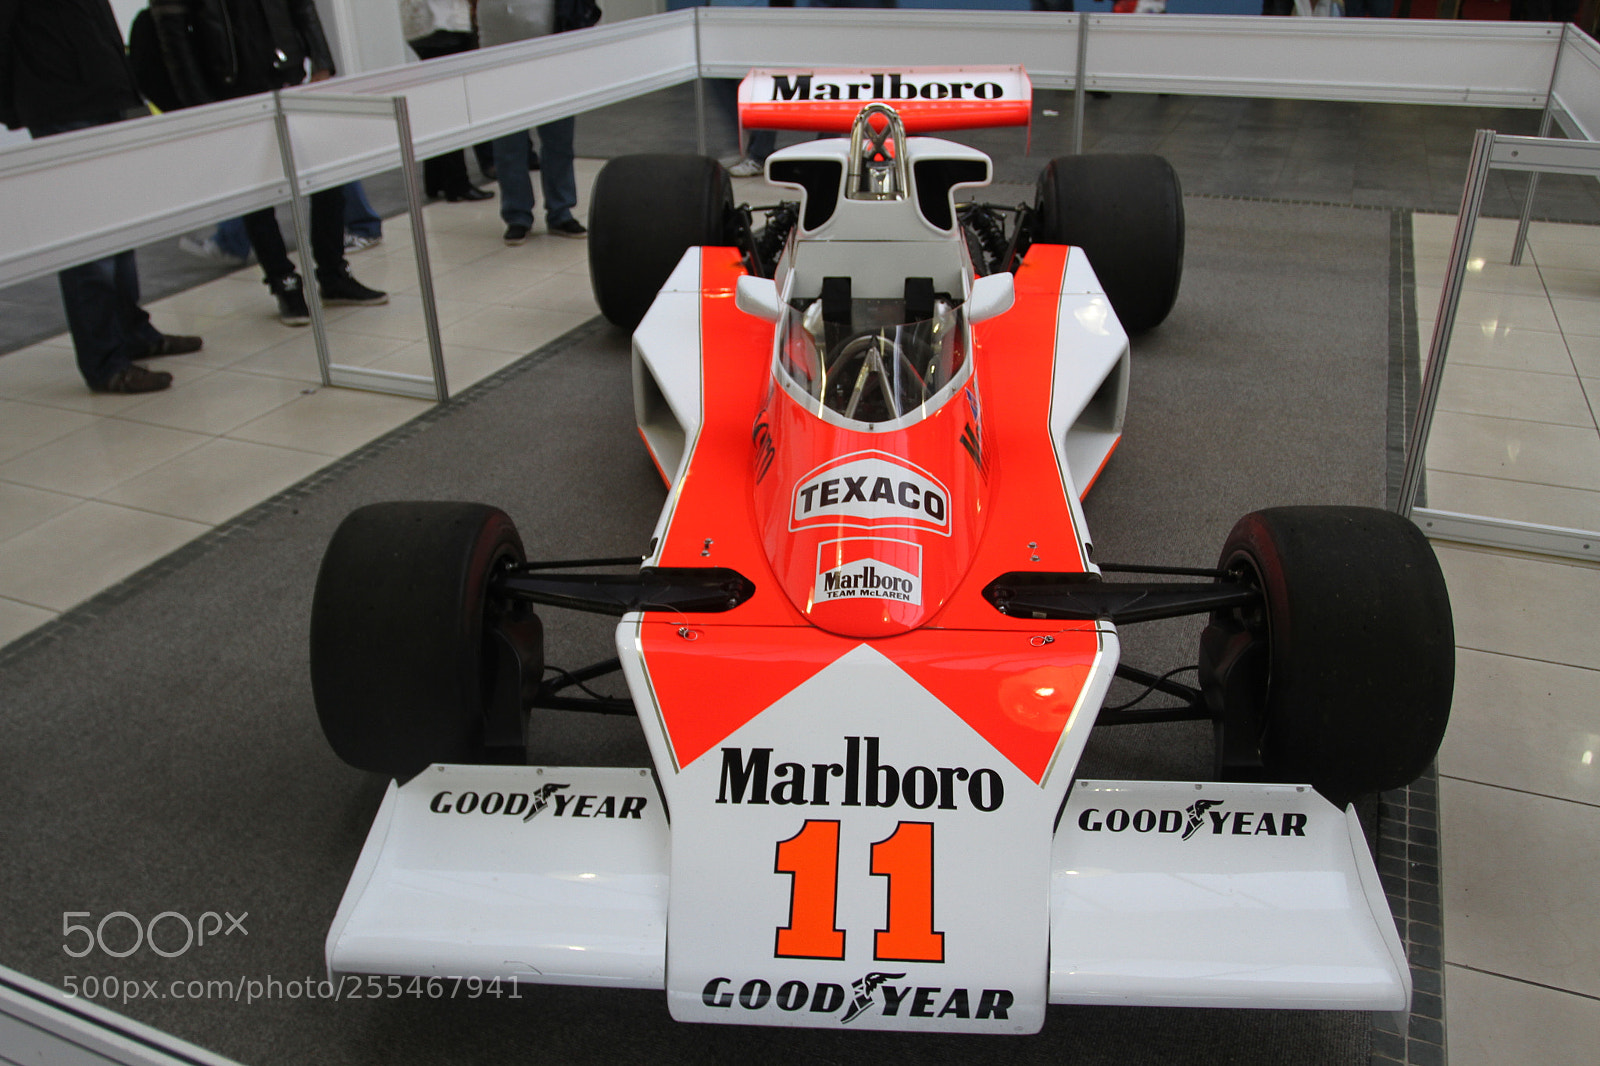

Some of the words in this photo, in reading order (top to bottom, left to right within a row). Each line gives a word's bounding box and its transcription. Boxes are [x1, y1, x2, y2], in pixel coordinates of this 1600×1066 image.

[771, 74, 1004, 101] Marlboro
[801, 476, 945, 521] TEXACO
[824, 566, 913, 594] Marlboro
[826, 589, 856, 599] TEAM
[859, 589, 910, 601] McLAREN
[715, 736, 1005, 812] Marlboro
[773, 819, 945, 963] 11
